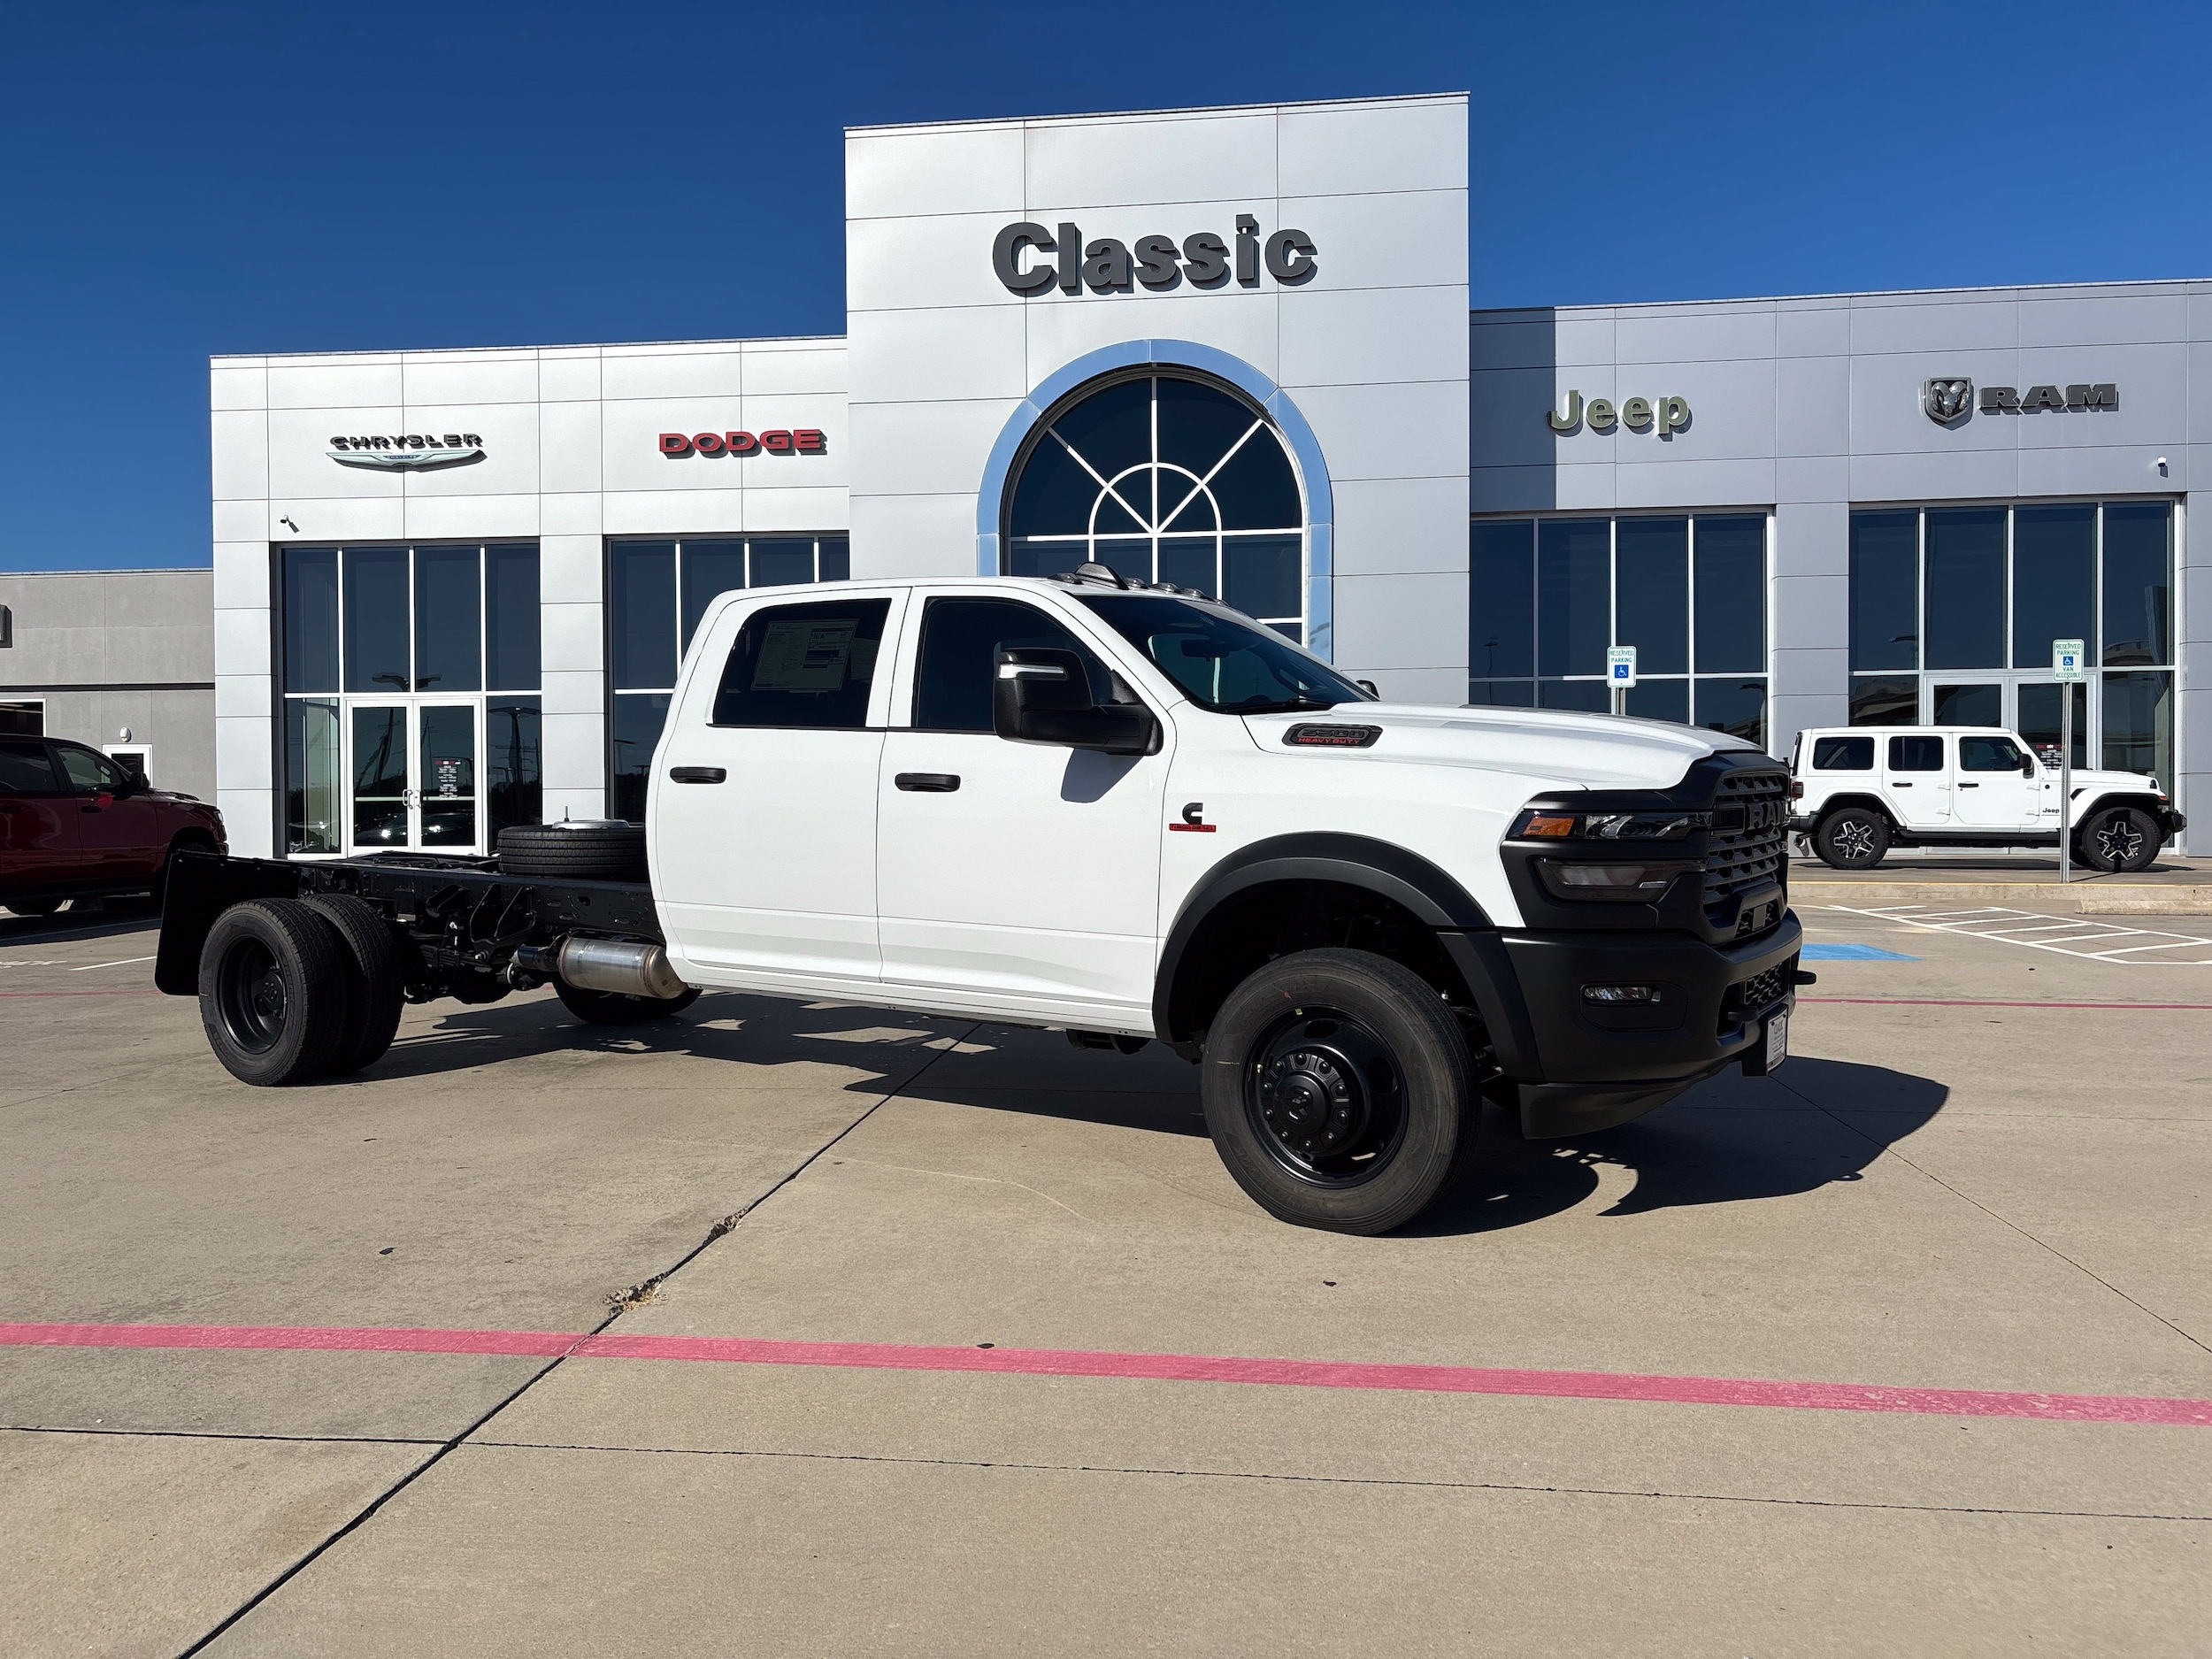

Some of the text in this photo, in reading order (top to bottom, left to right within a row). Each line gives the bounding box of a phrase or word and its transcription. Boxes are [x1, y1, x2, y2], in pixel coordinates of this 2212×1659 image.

[993, 214, 1315, 290] Classic
[1981, 384, 2116, 408] RAM
[1548, 390, 1689, 434] Jeep
[330, 434, 482, 449] CHRYSLER
[659, 429, 822, 454] DODGE
